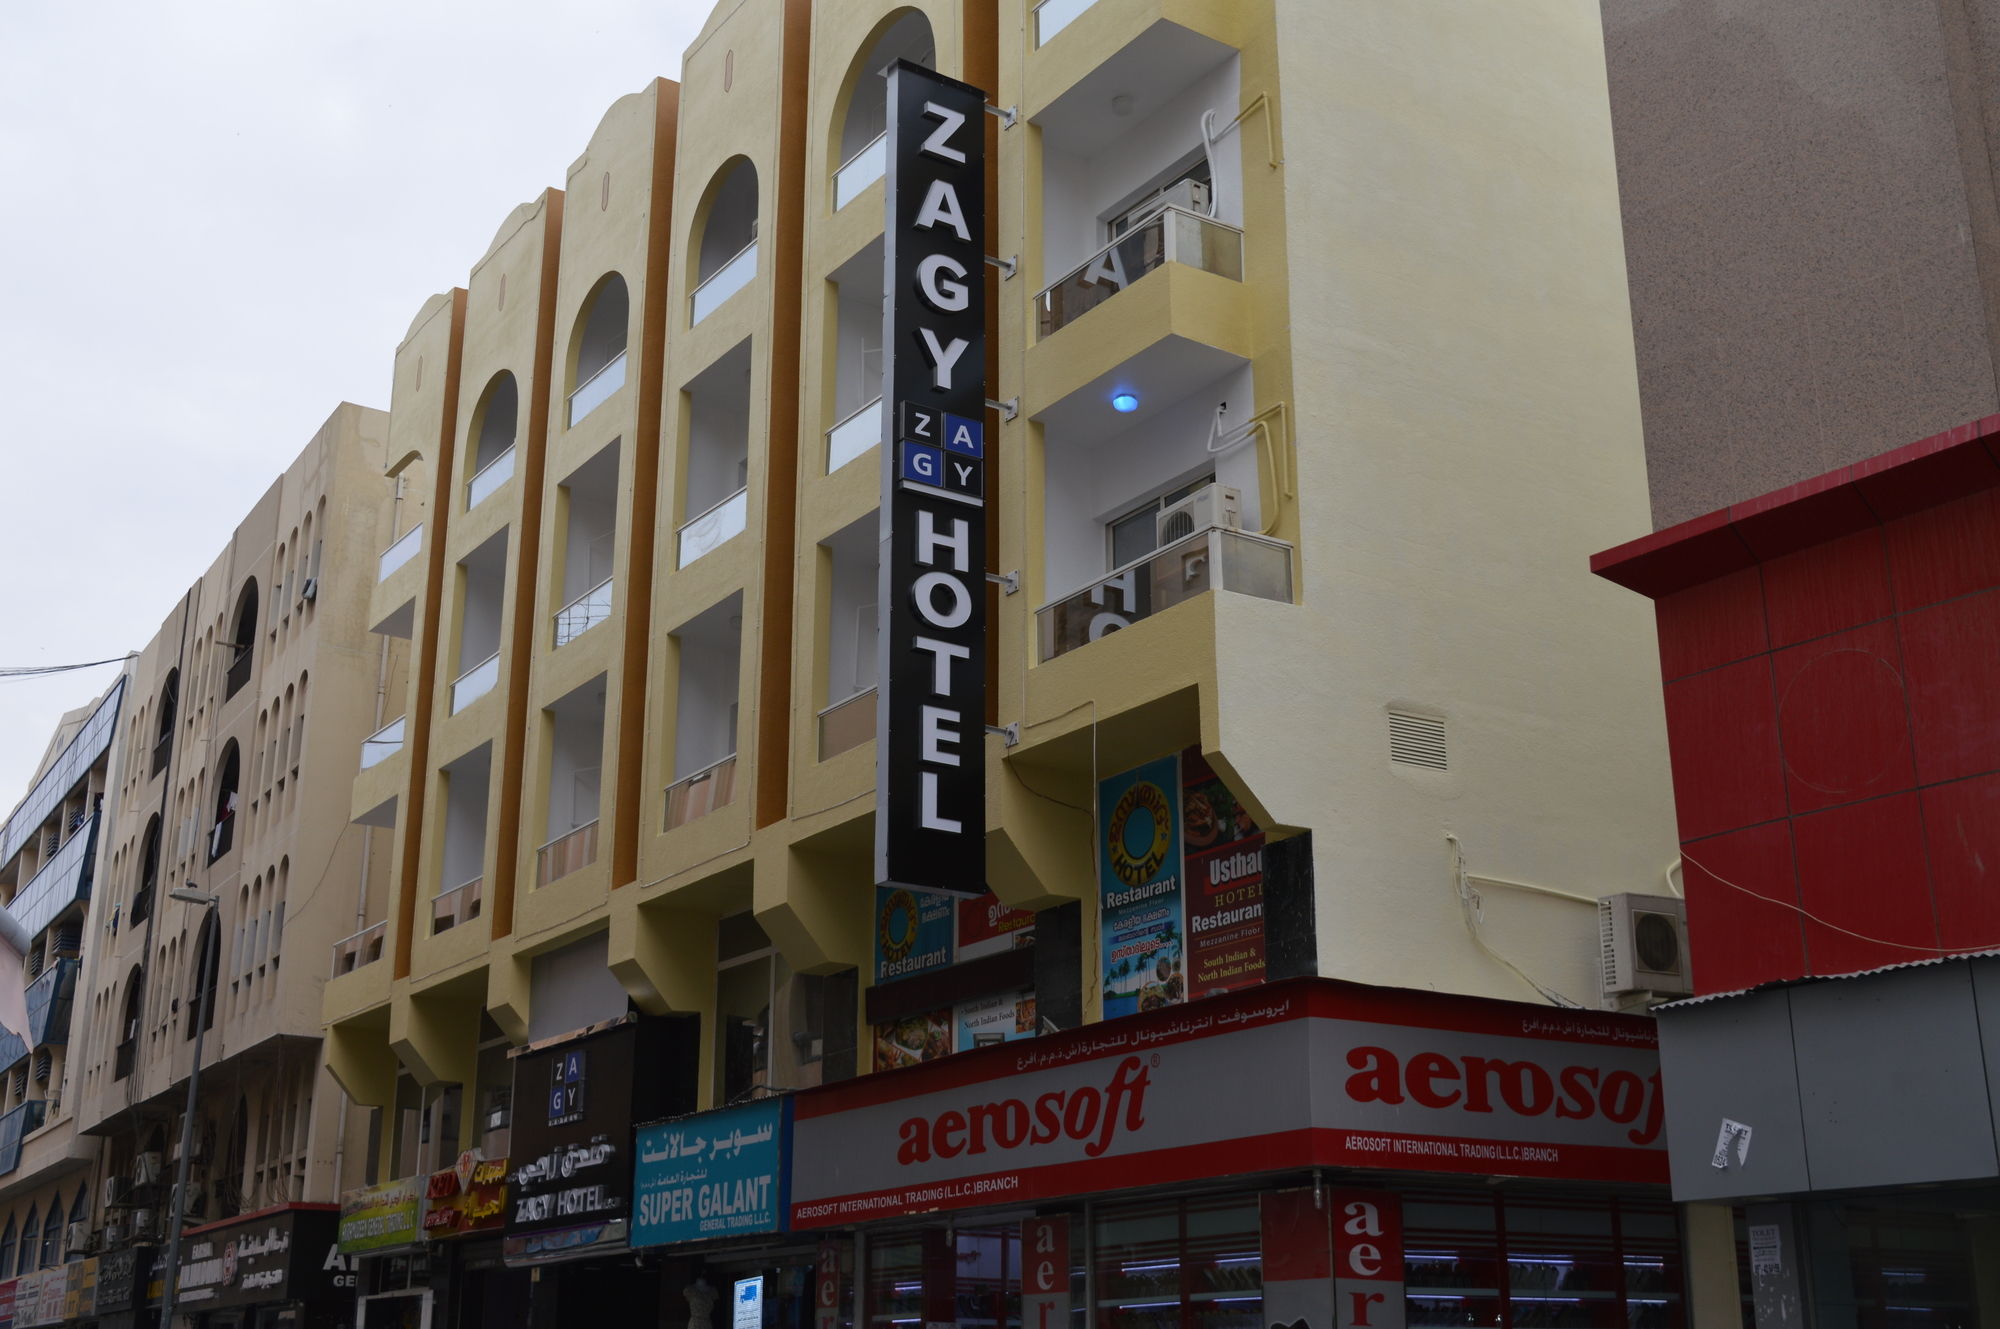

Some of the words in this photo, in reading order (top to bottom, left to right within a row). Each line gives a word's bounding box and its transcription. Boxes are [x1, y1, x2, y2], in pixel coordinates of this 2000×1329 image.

[912, 100, 972, 393] ZAGY
[911, 509, 972, 834] HOTEL
[1113, 852, 1165, 883] HOTEL
[1106, 875, 1176, 908] Restaurant
[1191, 902, 1264, 934] Restauran
[1200, 933, 1239, 948] Mezzanine
[1241, 927, 1261, 938] Floor
[880, 946, 947, 979] Restaurant
[1198, 970, 1218, 983] North
[1220, 964, 1242, 978] Indian
[1244, 959, 1266, 972] Foods
[1204, 954, 1224, 969] South
[1225, 951, 1248, 964] Indian
[1249, 947, 1256, 957] &
[964, 1017, 980, 1029] North
[980, 1014, 998, 1026] Indian
[999, 1009, 1015, 1021] Foods
[897, 1056, 1150, 1166] aerosoft
[561, 1135, 615, 1178] فندق
[642, 1130, 707, 1164] جالانت
[709, 1122, 773, 1161] سوبر
[1345, 1136, 1391, 1152] AEROSOFT
[1393, 1139, 1458, 1157] INTERNATIONAL
[515, 1193, 556, 1223] ZAGY
[557, 1184, 605, 1216] HOTEL
[640, 1187, 693, 1227] SUPER
[698, 1175, 771, 1219] GALANT
[796, 1203, 837, 1219] AEROSOFT
[839, 1194, 902, 1214] INTERNATIONAL
[700, 1220, 726, 1232] GENERAL
[727, 1214, 753, 1229] TRADING
[1344, 1201, 1384, 1327] aer
